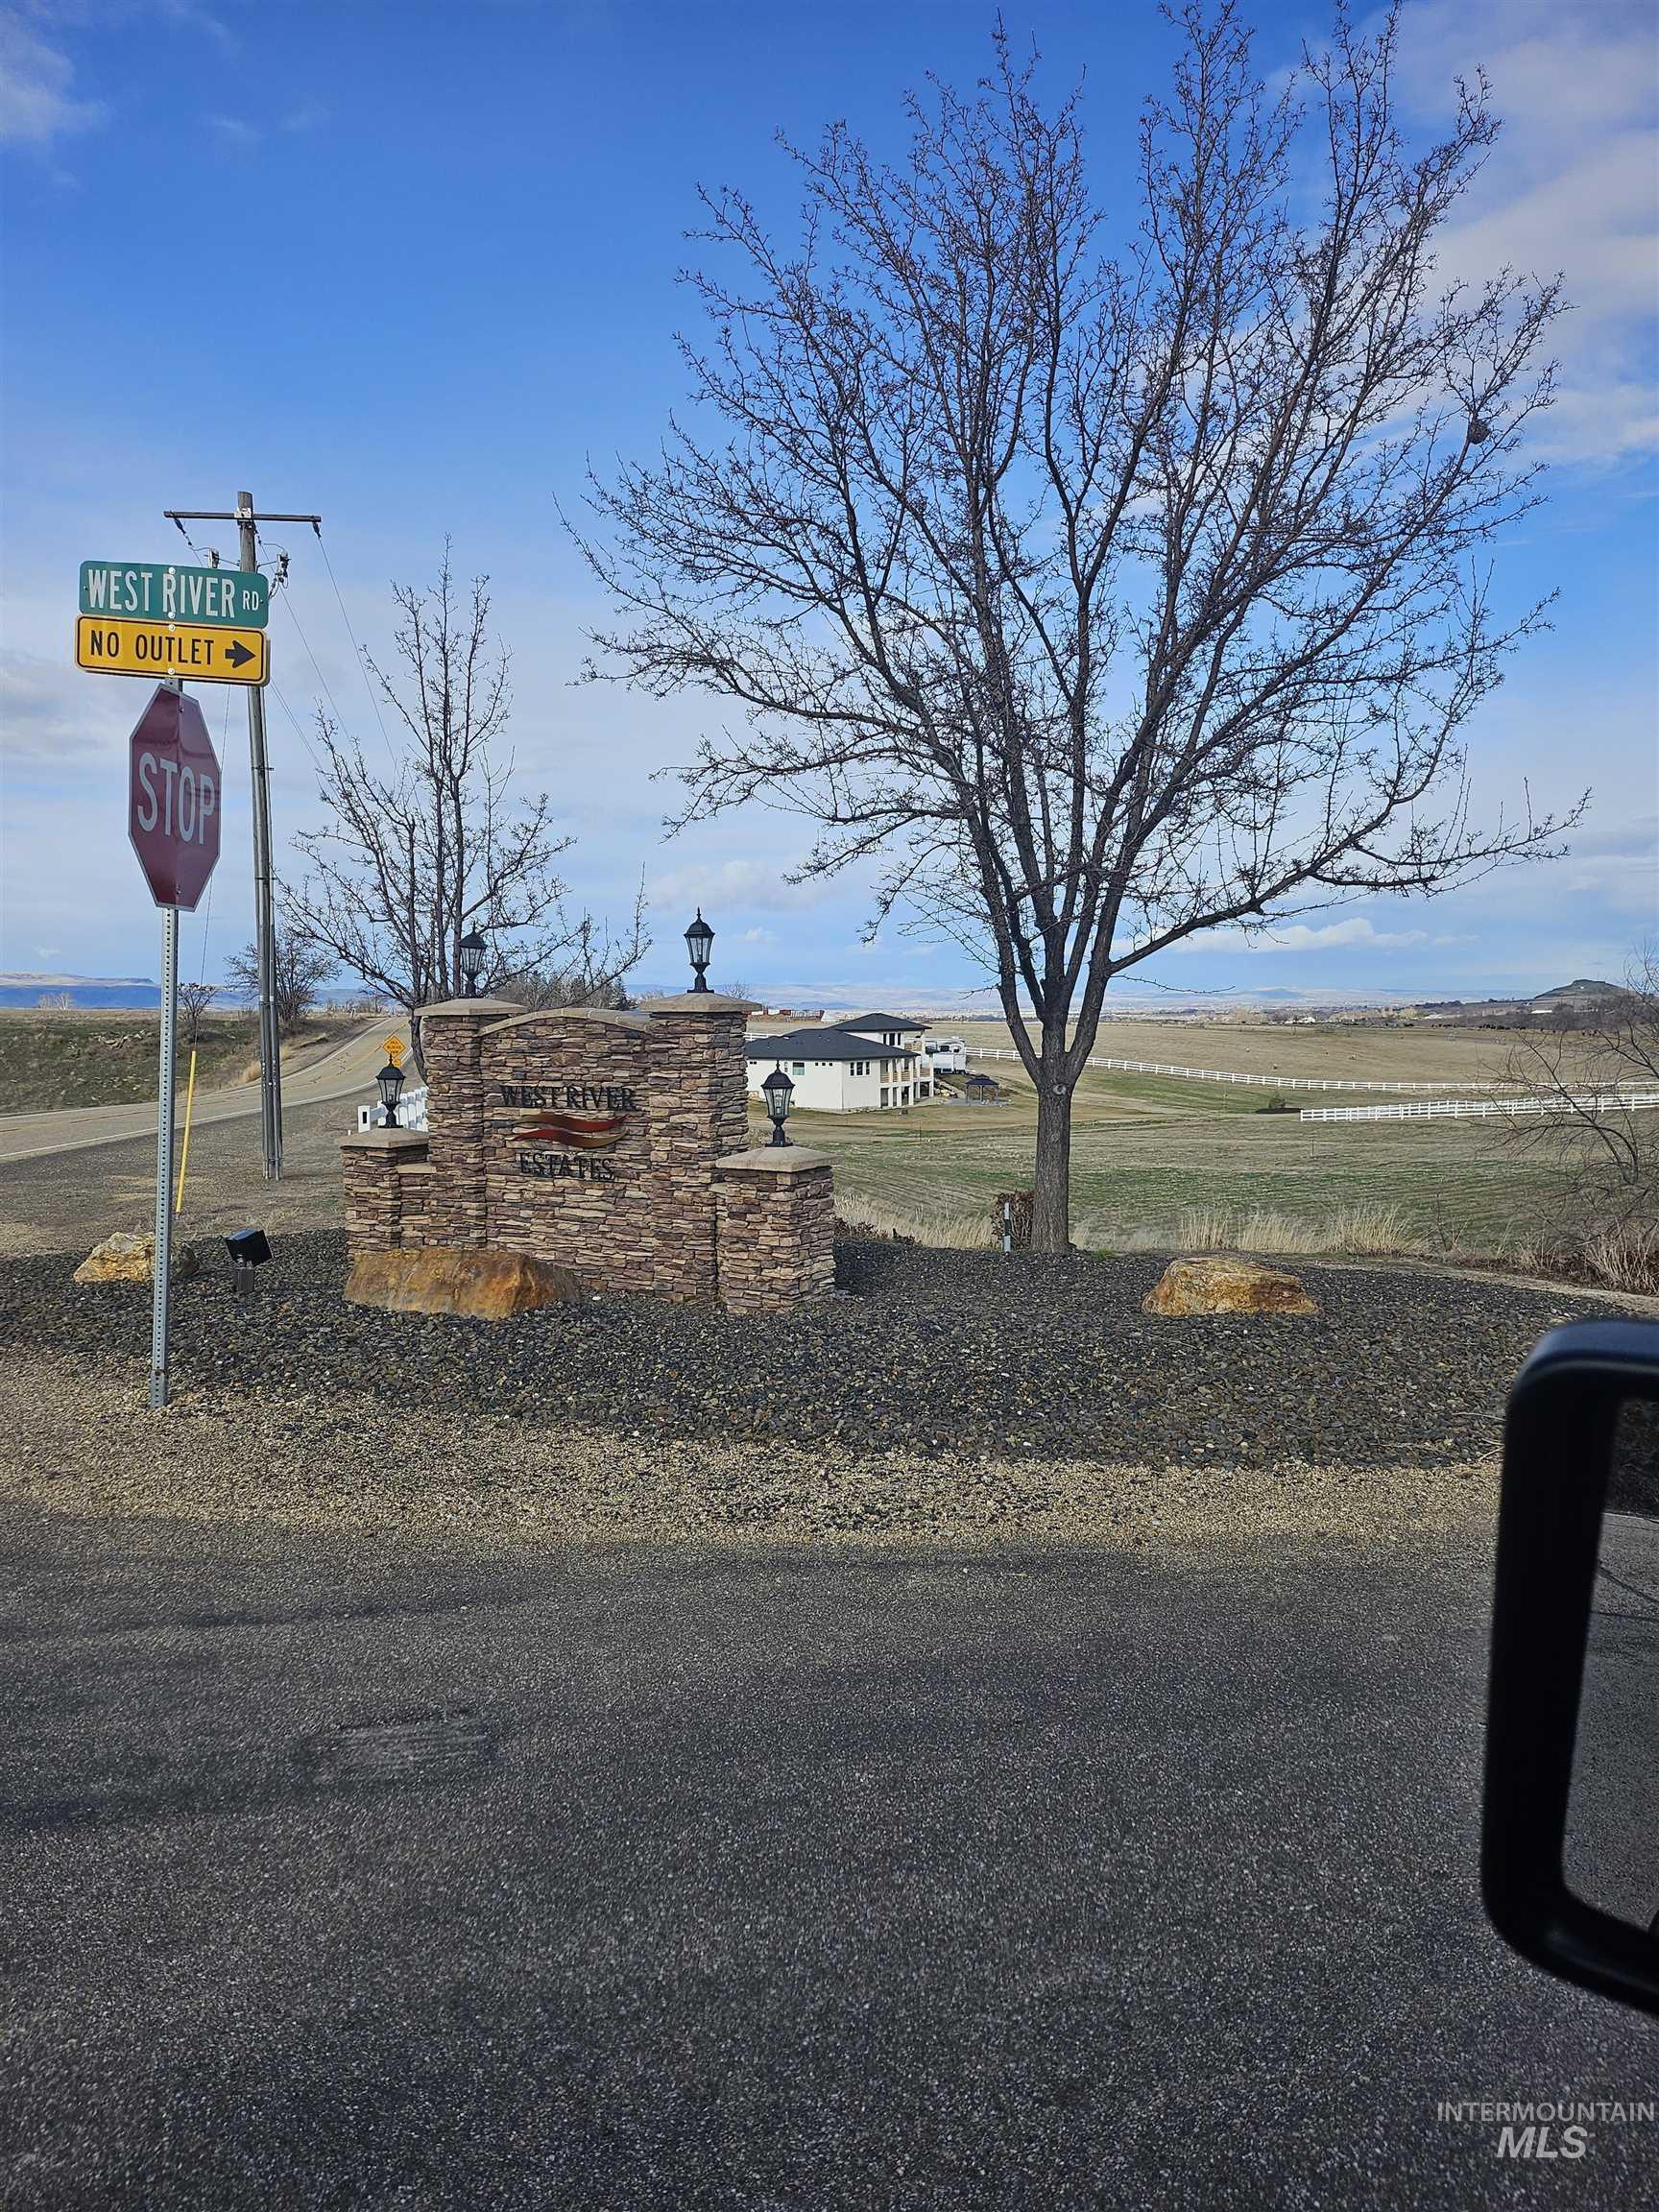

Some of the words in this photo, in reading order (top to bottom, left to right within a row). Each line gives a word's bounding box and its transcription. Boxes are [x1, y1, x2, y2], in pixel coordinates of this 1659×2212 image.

[87, 568, 153, 612] WEST
[162, 573, 235, 617] RIVER
[243, 590, 259, 612] RD
[90, 630, 119, 658] NO
[135, 634, 214, 665] OUTLET
[137, 752, 215, 845] STOP
[500, 1086, 560, 1108] WEST
[566, 1086, 640, 1111] RIVER
[520, 1152, 615, 1182] ESTATES
